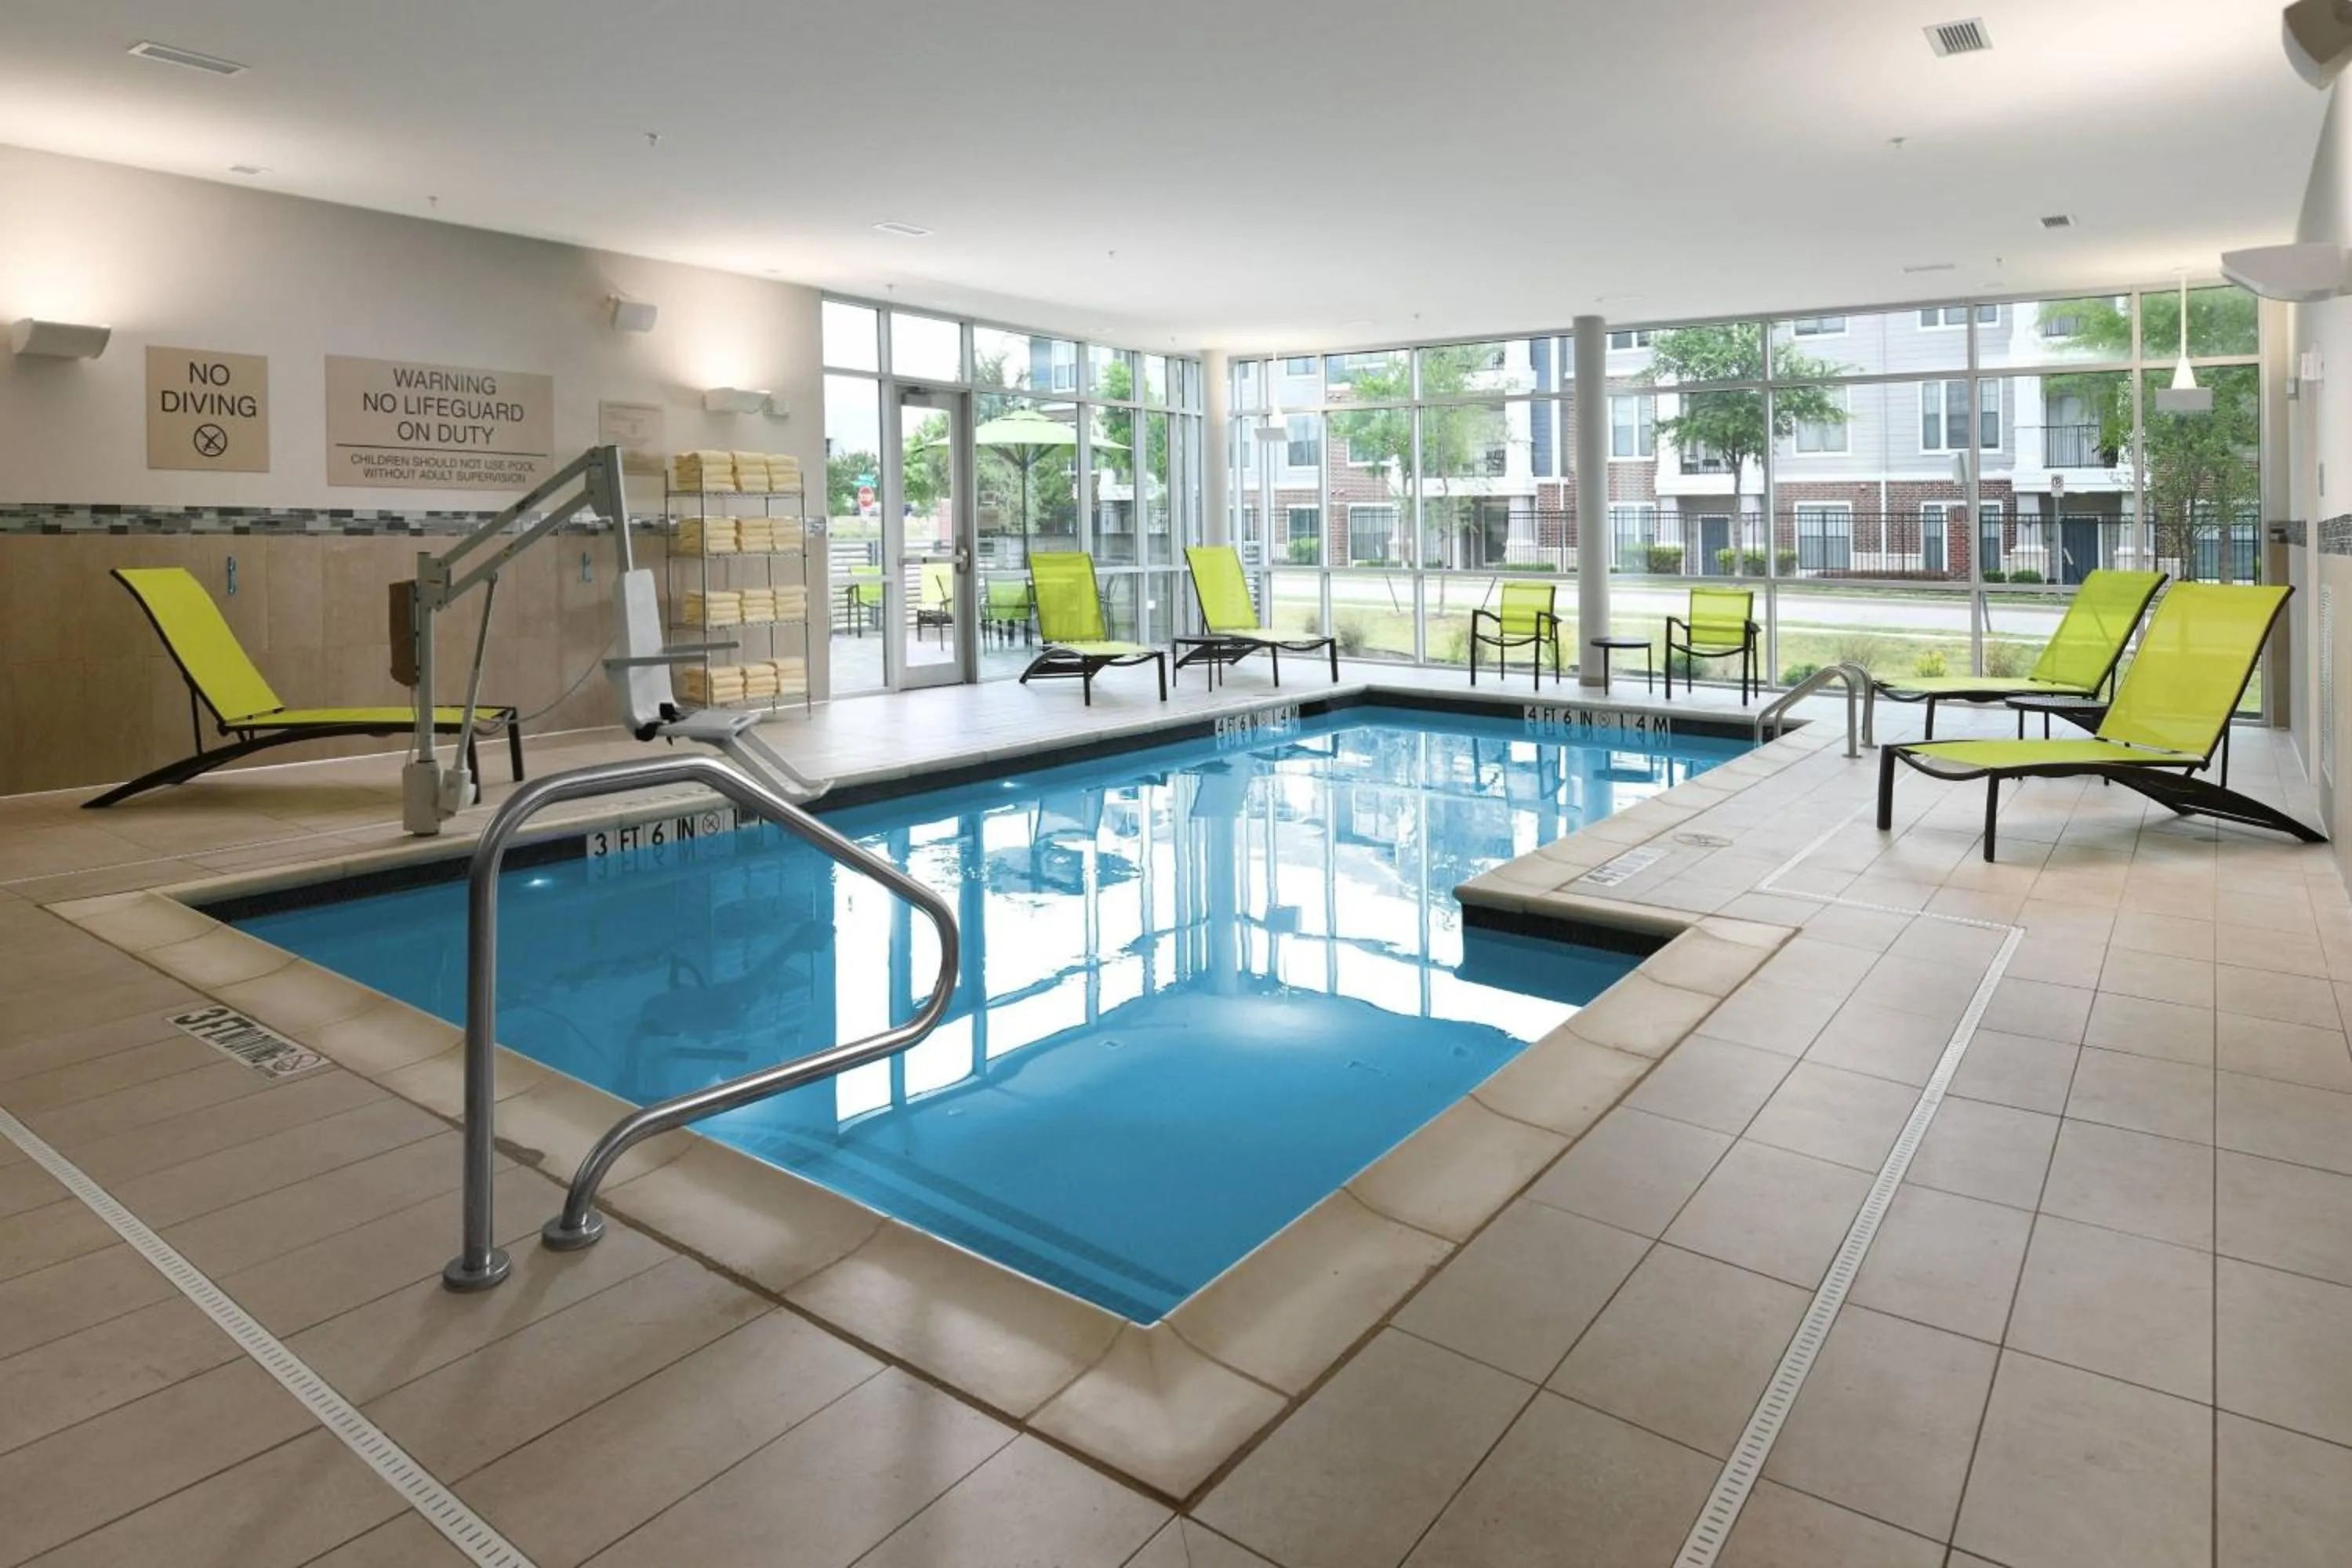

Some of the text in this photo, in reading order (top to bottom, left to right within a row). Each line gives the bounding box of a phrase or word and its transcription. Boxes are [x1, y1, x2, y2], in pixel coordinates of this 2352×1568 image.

[189, 361, 230, 386] NO
[394, 367, 496, 395] WARNING
[161, 390, 256, 418] DIVING
[363, 392, 524, 423] NO LIFEGUARD
[397, 421, 494, 445] ON DUTY
[350, 453, 535, 473] CHILDREN SHOULD NOT USE POOL
[363, 467, 526, 484] WITHOUT ADULT SUPERVISION
[1527, 707, 1537, 720] 4
[1544, 708, 1556, 723] FT
[1563, 710, 1573, 725] 6
[1580, 710, 1593, 726] IN
[1635, 716, 1646, 728] 4
[1653, 717, 1668, 732] M
[594, 833, 608, 856] 3
[620, 826, 641, 852] FT
[652, 822, 664, 845] 6
[677, 817, 695, 841] IN
[173, 1007, 229, 1025] 3
